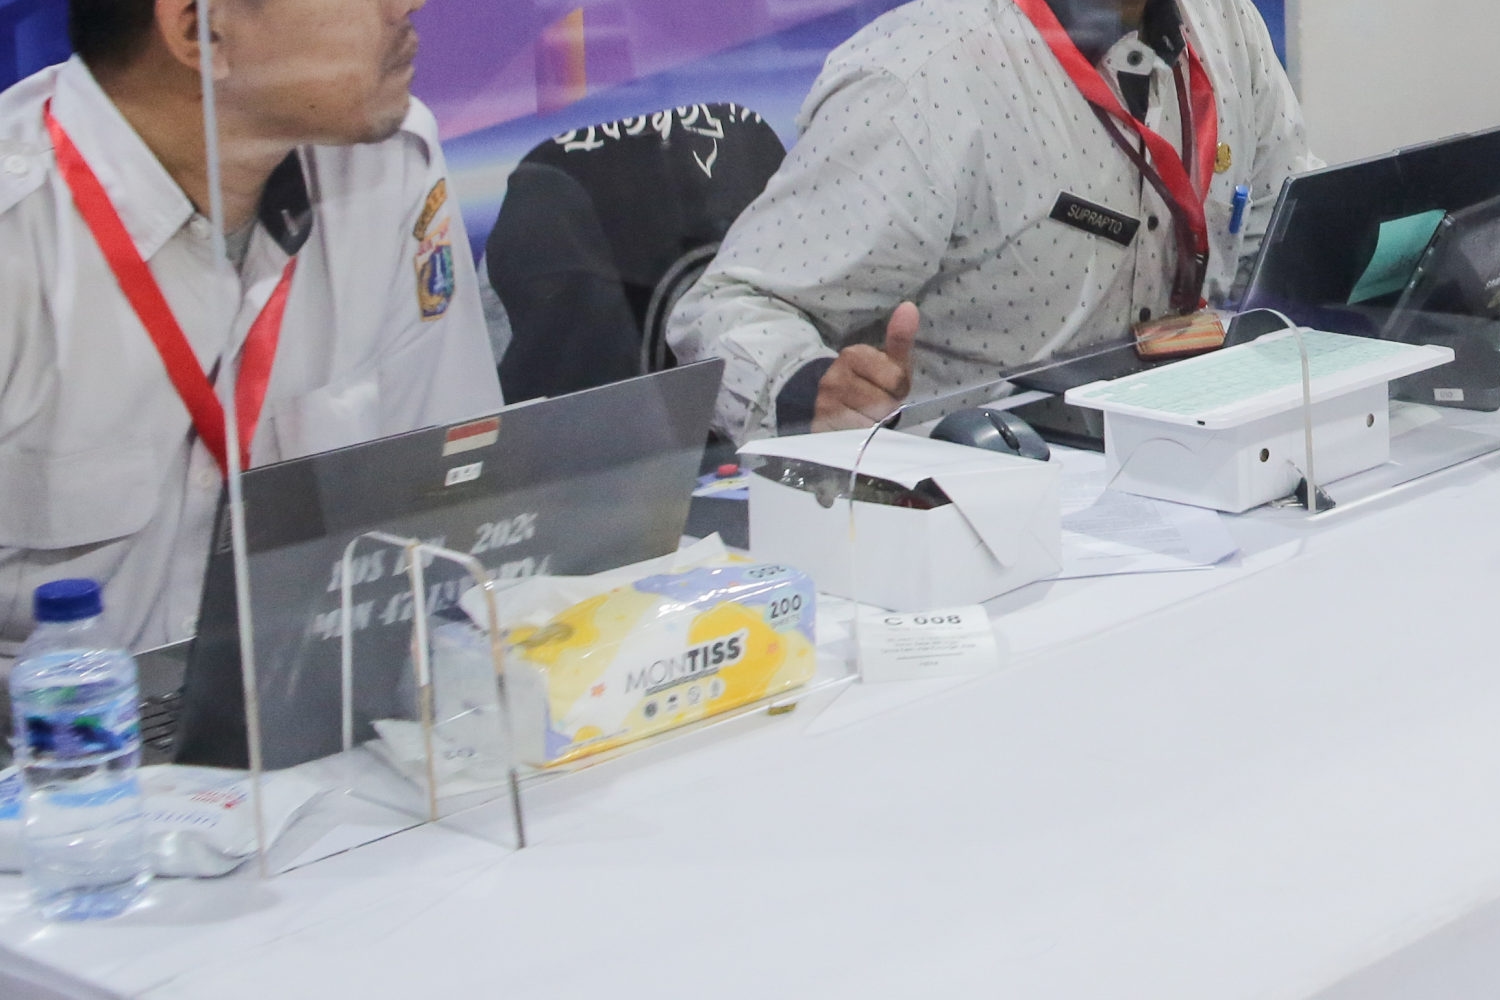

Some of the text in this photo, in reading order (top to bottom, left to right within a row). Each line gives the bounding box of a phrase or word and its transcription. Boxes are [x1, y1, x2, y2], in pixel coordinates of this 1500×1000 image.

[1067, 203, 1123, 235] SUPRAPTO
[770, 594, 802, 619] 200
[624, 636, 744, 694] MONTISS
